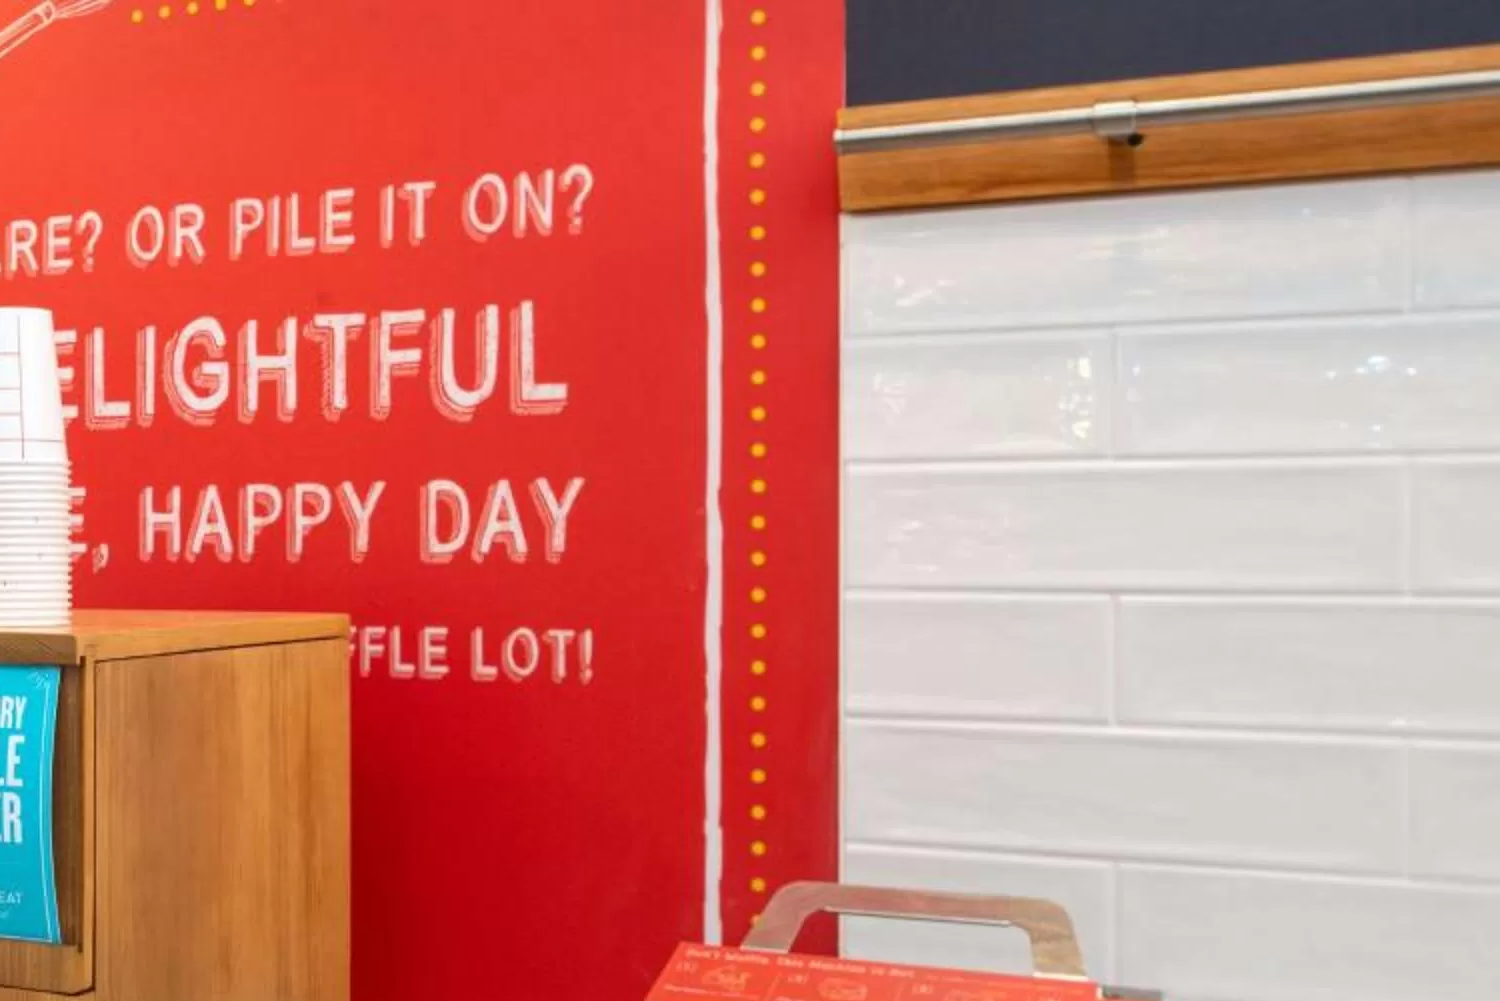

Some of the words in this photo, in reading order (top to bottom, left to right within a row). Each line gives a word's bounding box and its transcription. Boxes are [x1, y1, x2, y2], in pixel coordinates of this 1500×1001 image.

[126, 203, 205, 268] OR
[229, 187, 356, 262] PILE
[379, 181, 437, 247] IT
[462, 163, 595, 243] ON?
[53, 299, 569, 432] ELIGHTFUL
[139, 482, 386, 564] HAPPY
[420, 476, 585, 564] DAY
[470, 626, 593, 685] LOT!
